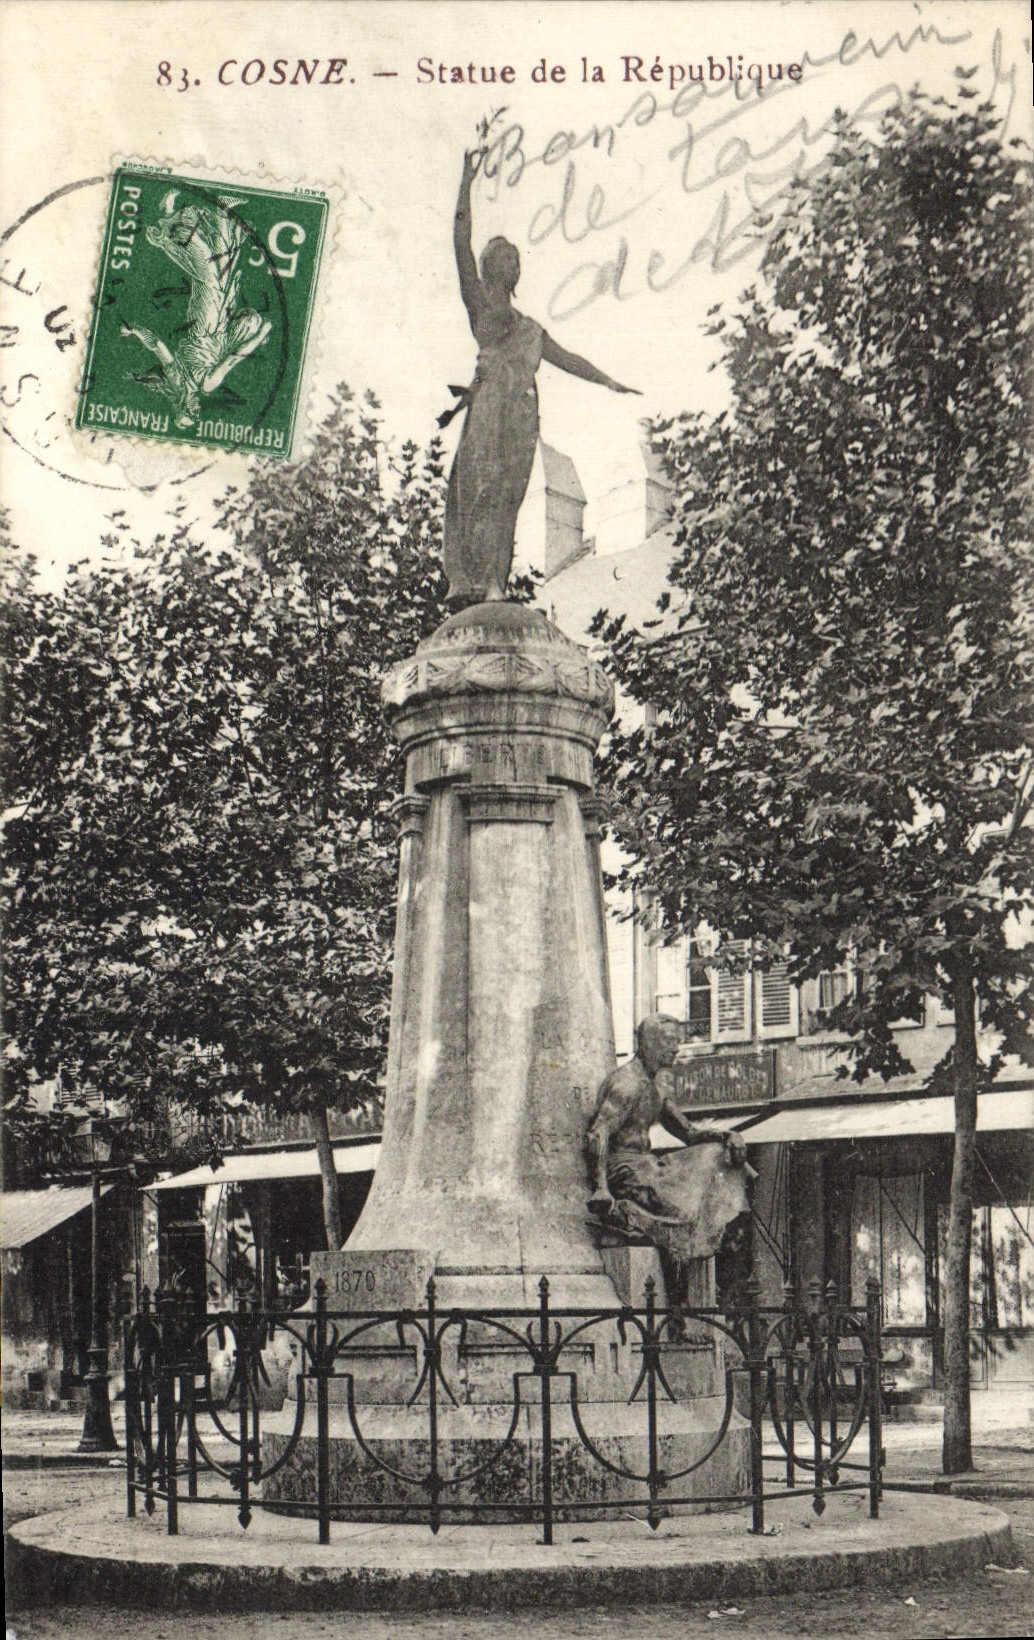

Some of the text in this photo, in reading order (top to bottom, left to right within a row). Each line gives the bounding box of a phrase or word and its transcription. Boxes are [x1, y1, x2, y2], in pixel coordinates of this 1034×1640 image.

[111, 185, 142, 271] POSTES
[88, 402, 170, 432] FRANÇAISE
[335, 1269, 376, 1293] 1870
